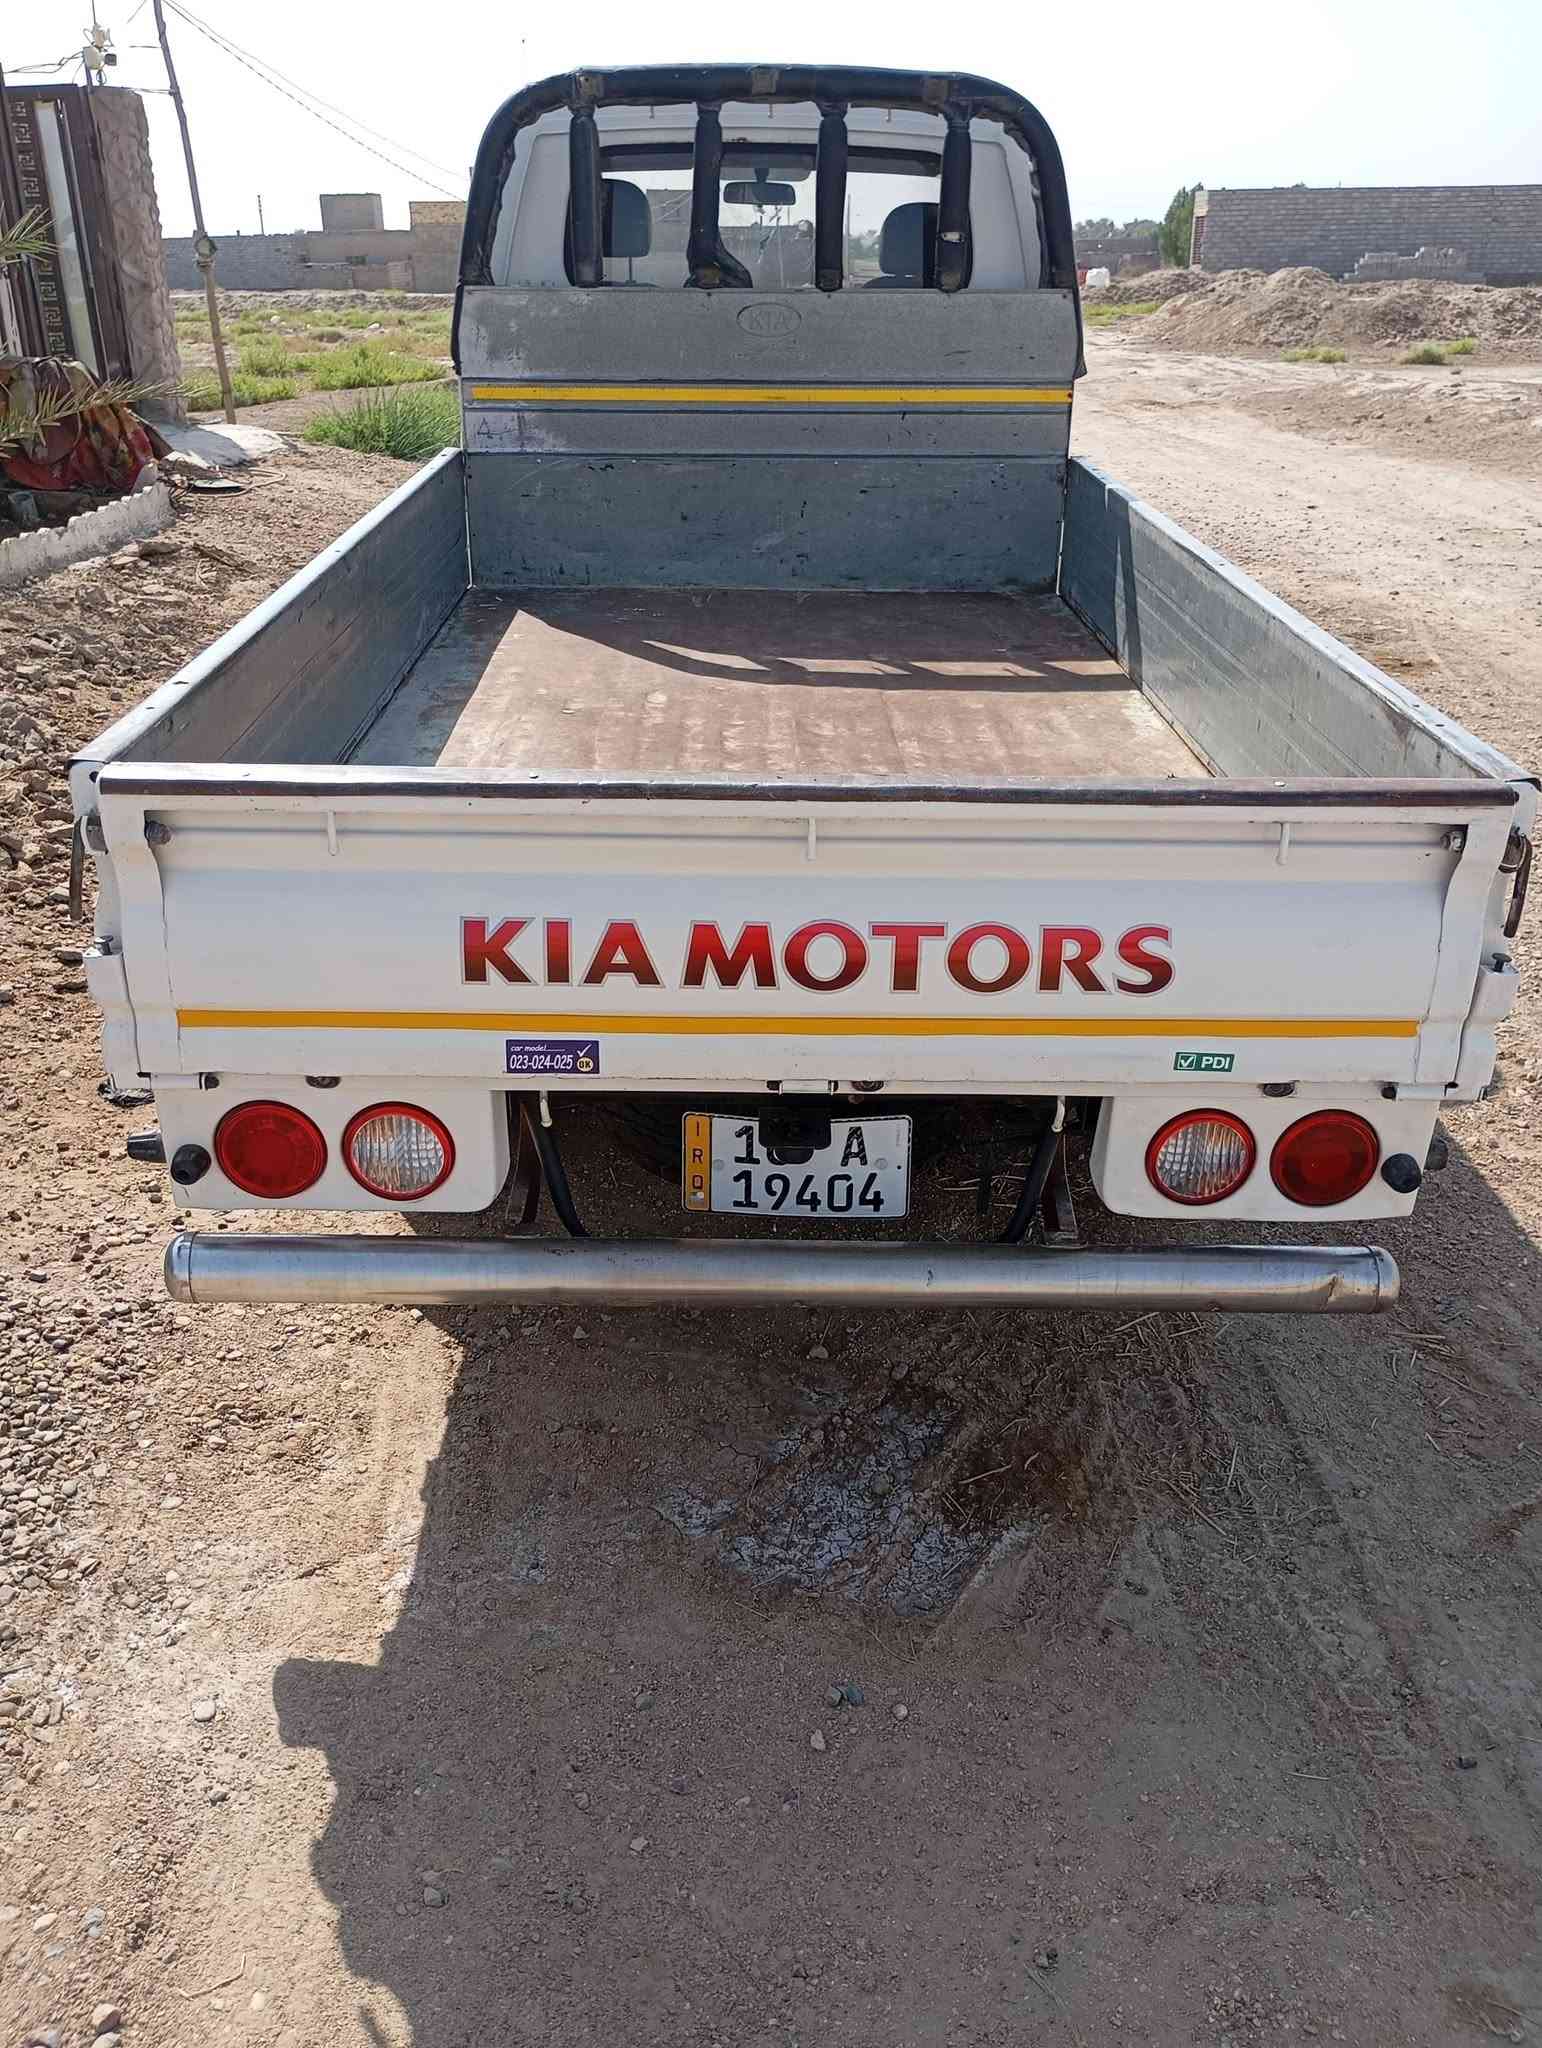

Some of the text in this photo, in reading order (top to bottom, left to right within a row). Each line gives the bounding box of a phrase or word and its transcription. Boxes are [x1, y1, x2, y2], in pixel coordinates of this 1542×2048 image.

[459, 915, 1176, 997] KIA MOTORS
[509, 1054, 574, 1070] 023-024-025
[578, 1059, 592, 1069] OK
[1201, 1056, 1231, 1070] PDI
[840, 1126, 868, 1167] A
[733, 1170, 885, 1213] 19404
